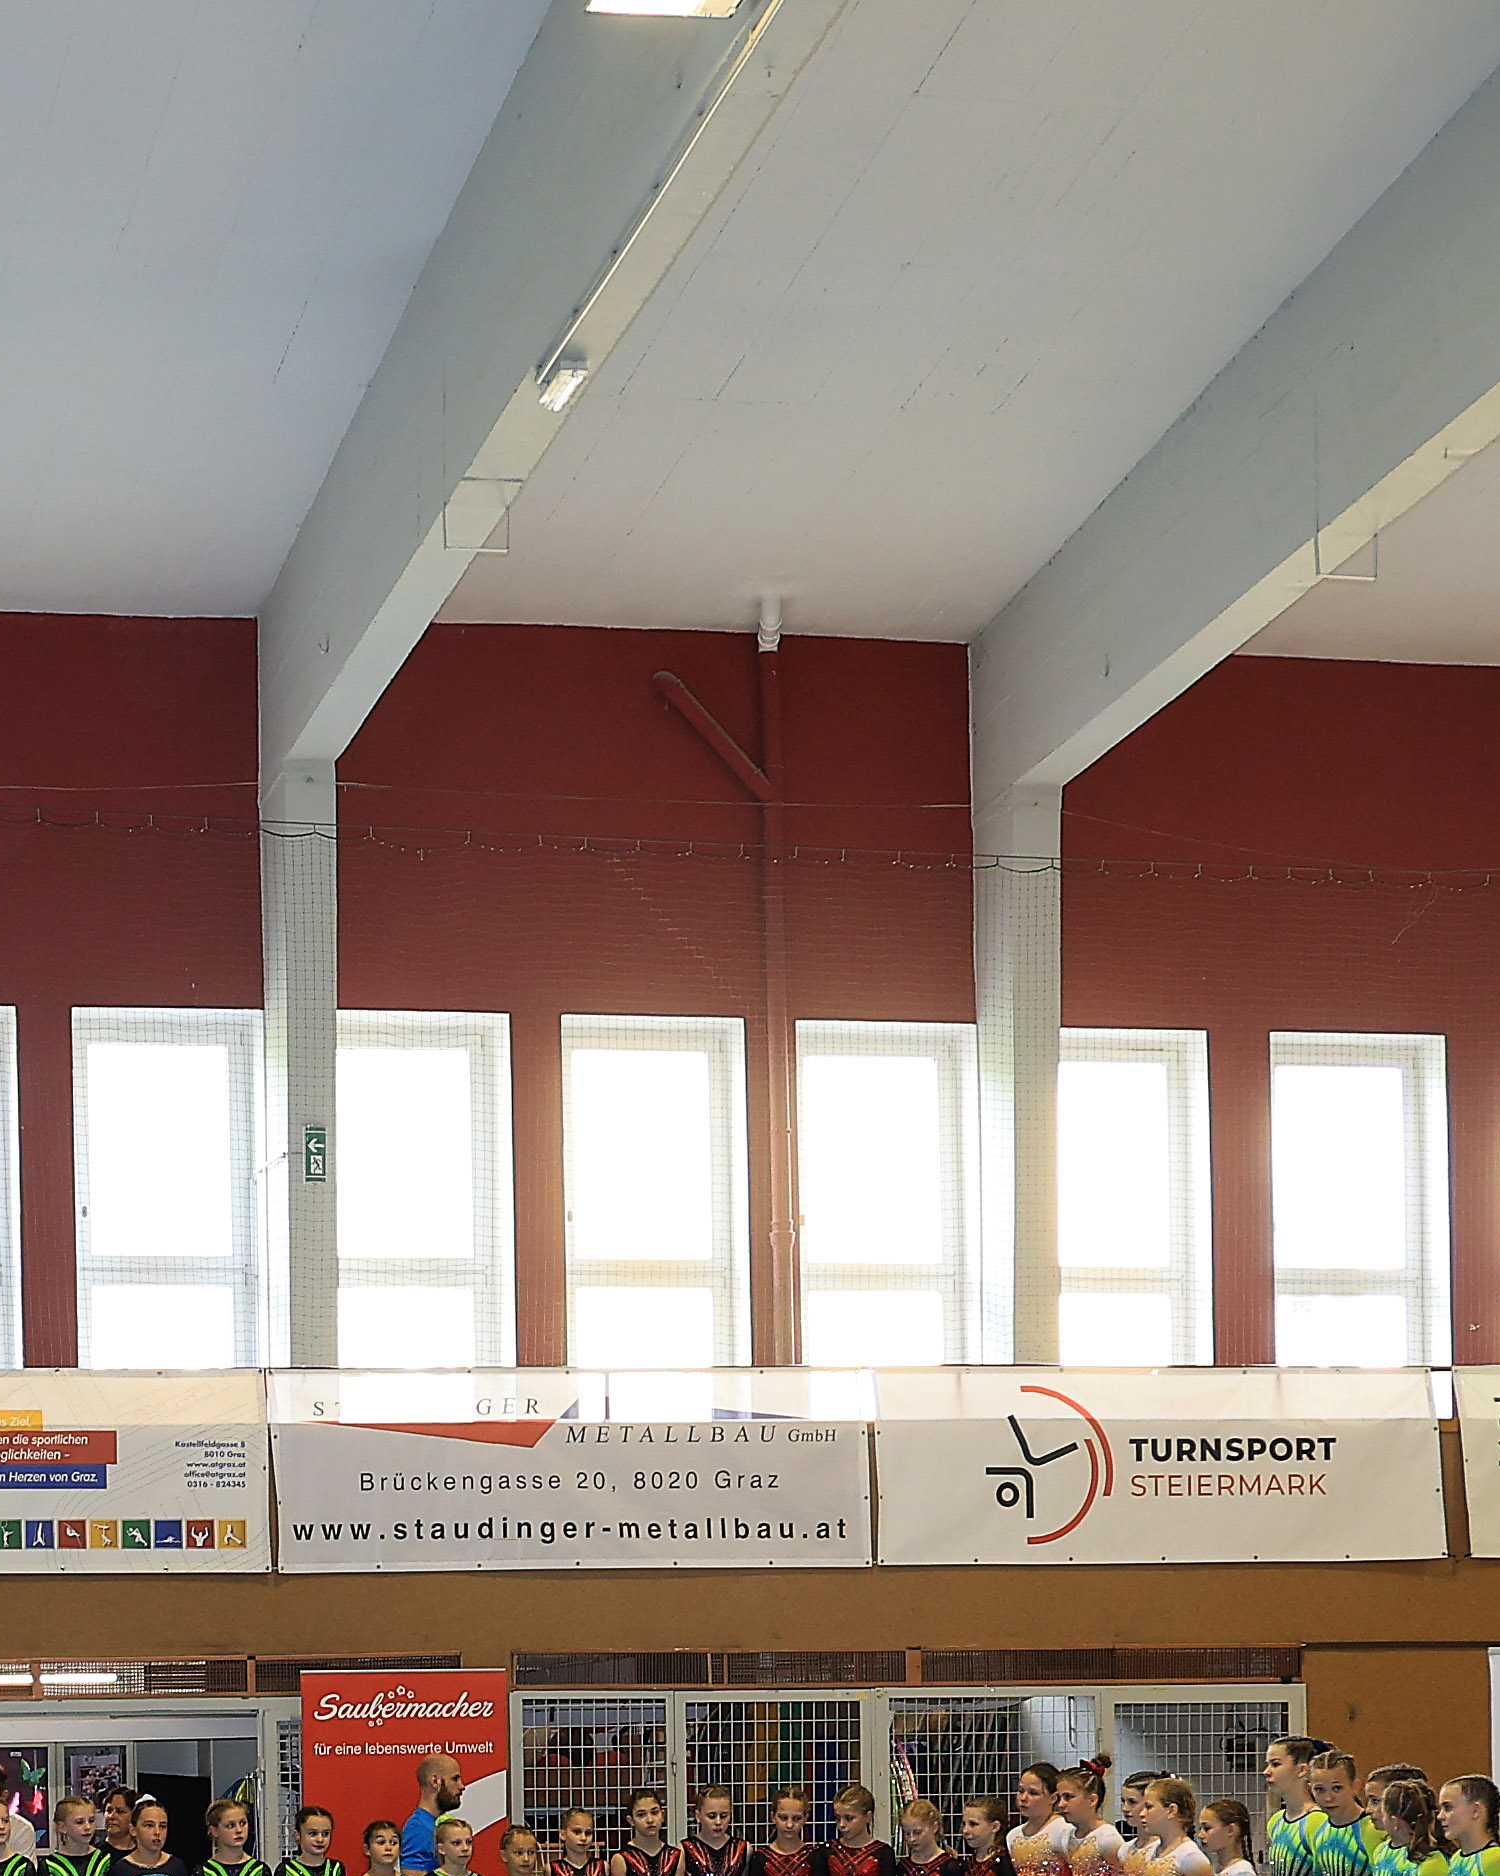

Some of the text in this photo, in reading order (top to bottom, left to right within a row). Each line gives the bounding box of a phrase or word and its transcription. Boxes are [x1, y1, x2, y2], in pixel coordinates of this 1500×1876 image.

[12, 1434, 29, 1445] die
[31, 1434, 88, 1447] sportlichen
[565, 1425, 836, 1444] METALLBAU GmbH
[1129, 1438, 1336, 1462] TURNSPORT
[8, 1471, 46, 1482] Herzen
[49, 1473, 68, 1482] von
[360, 1470, 780, 1495] Brückengasse 20, 8020 Graz
[1130, 1473, 1327, 1497] STEIERMARK
[293, 1517, 846, 1545] www.staudinger-metallbau.at
[314, 1691, 494, 1721] Saubermacher
[314, 1741, 493, 1755] für eine lebenswerte Umwelt
